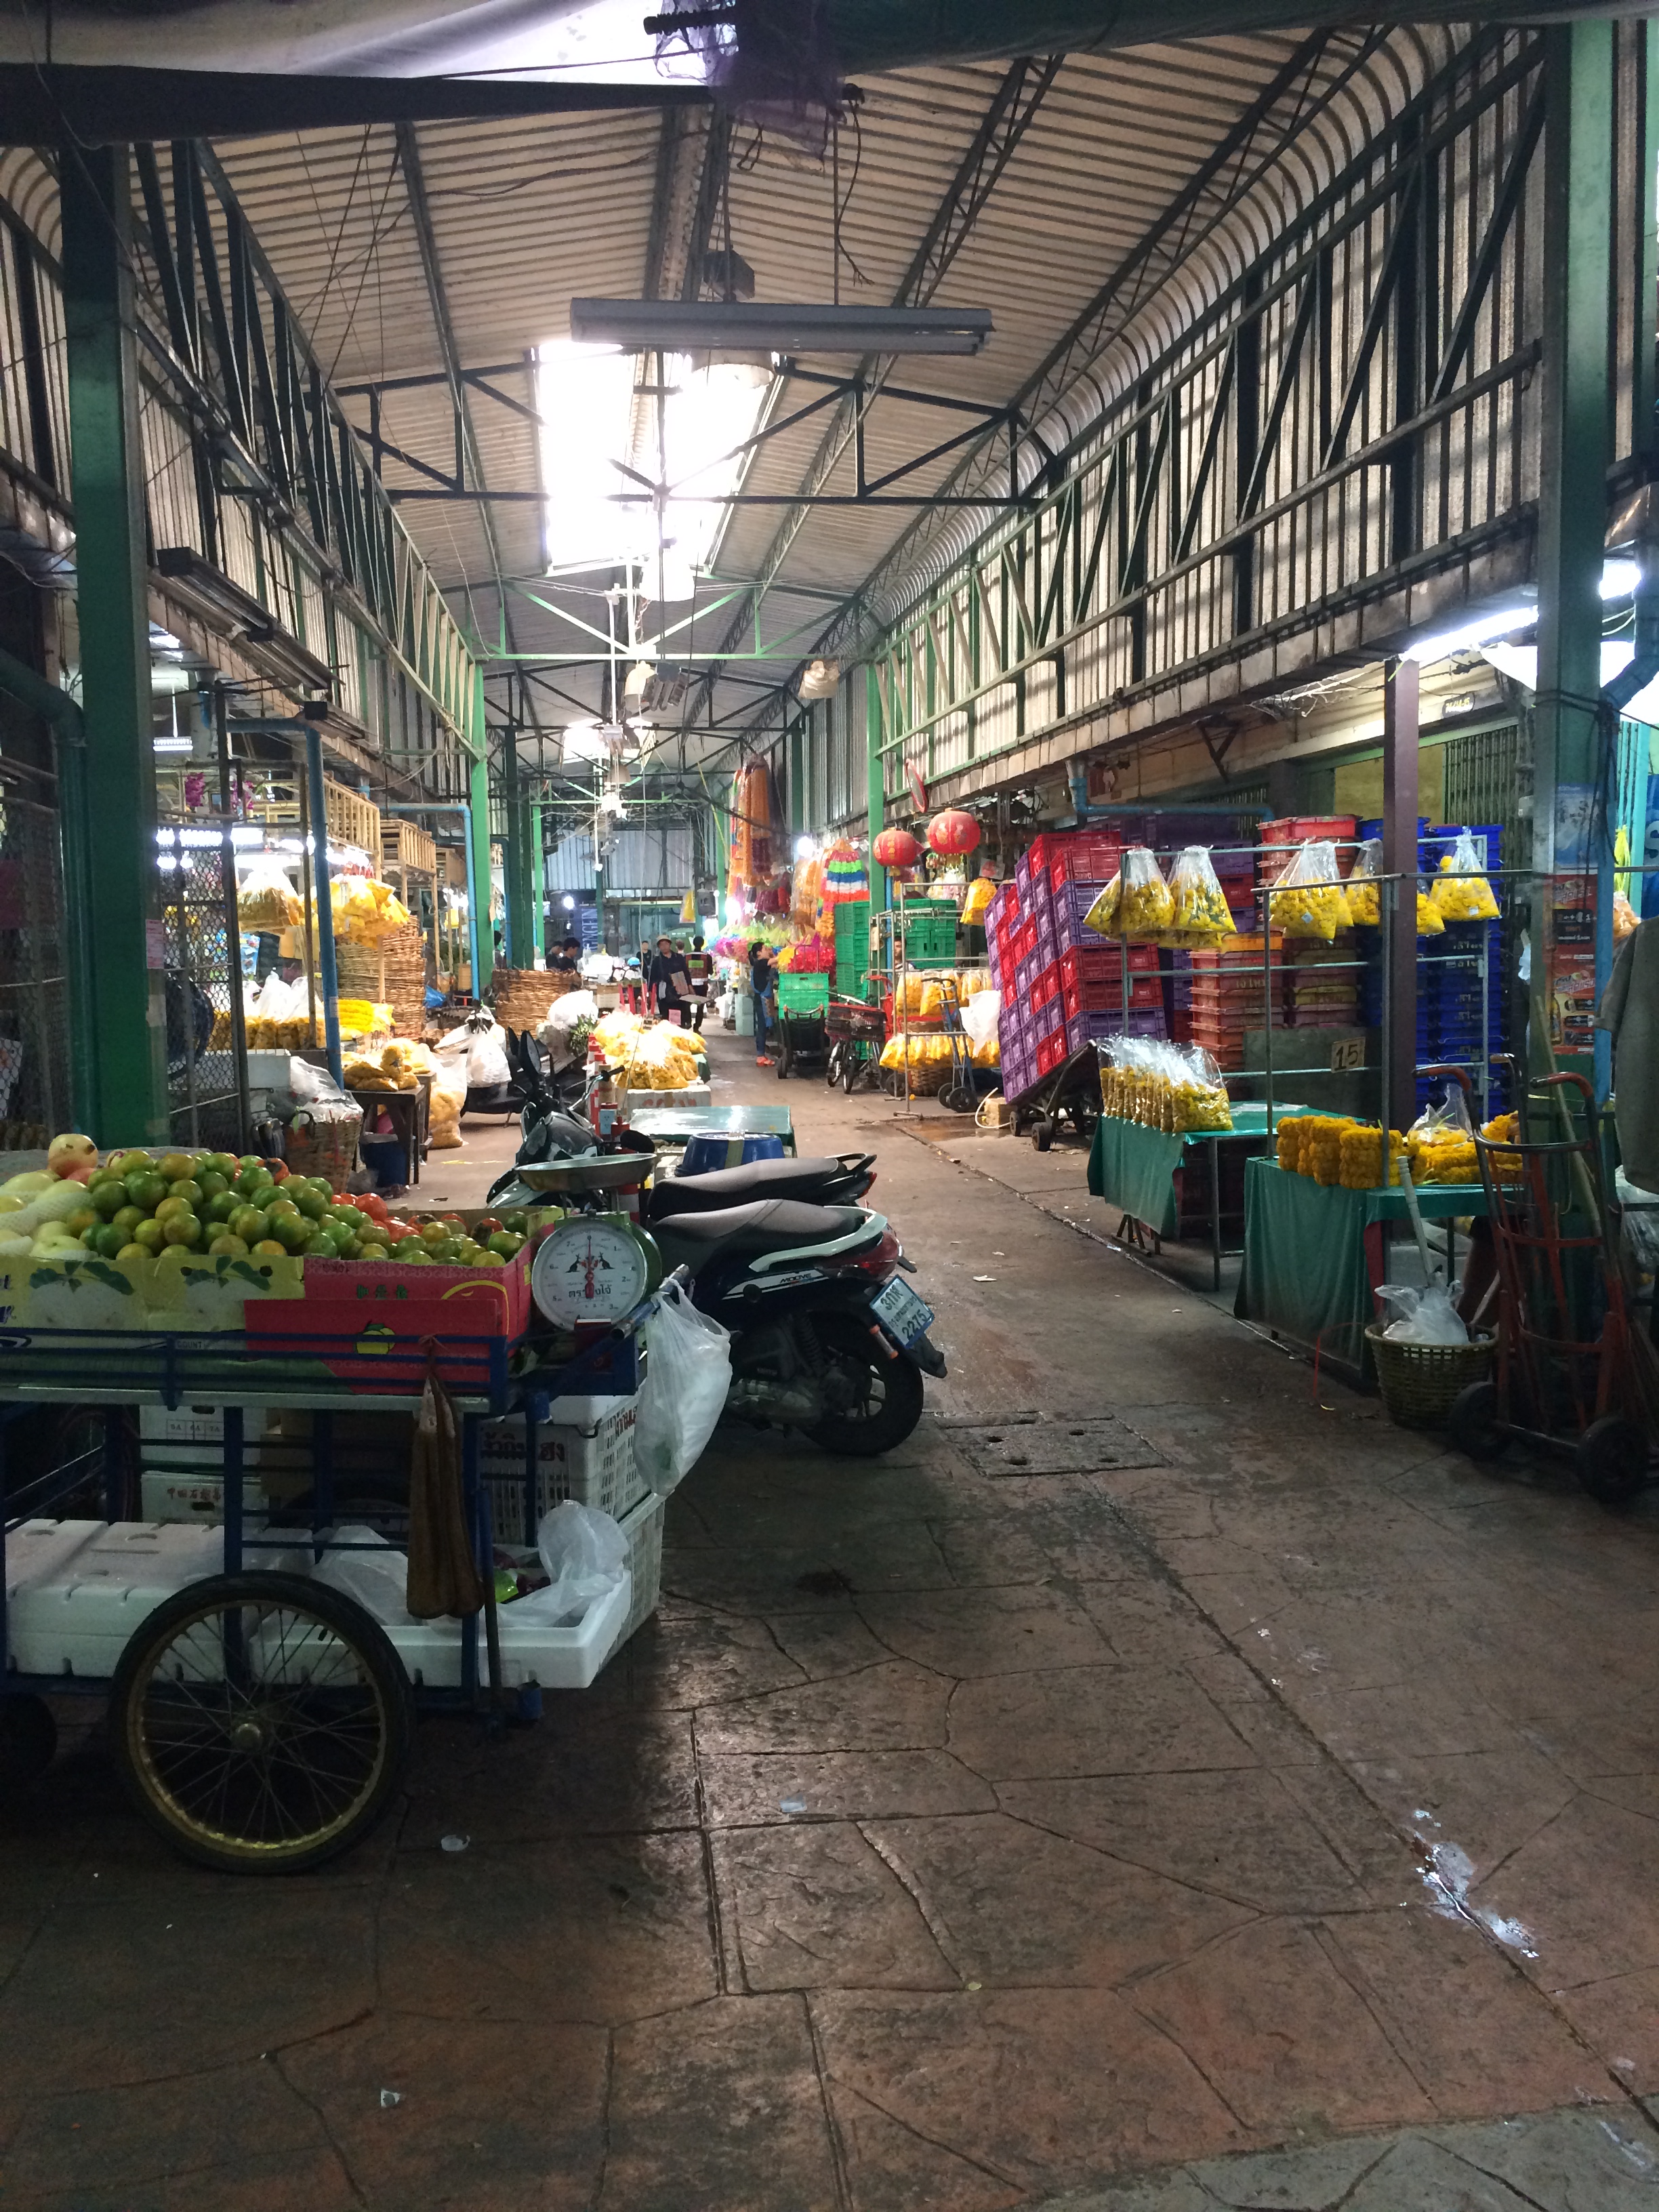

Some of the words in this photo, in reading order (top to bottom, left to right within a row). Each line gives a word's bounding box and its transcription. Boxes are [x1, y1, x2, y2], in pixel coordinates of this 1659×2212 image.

[1334, 1044, 1359, 1071] 15
[780, 1273, 811, 1284] MOOVE
[901, 1309, 927, 1340] 2275
